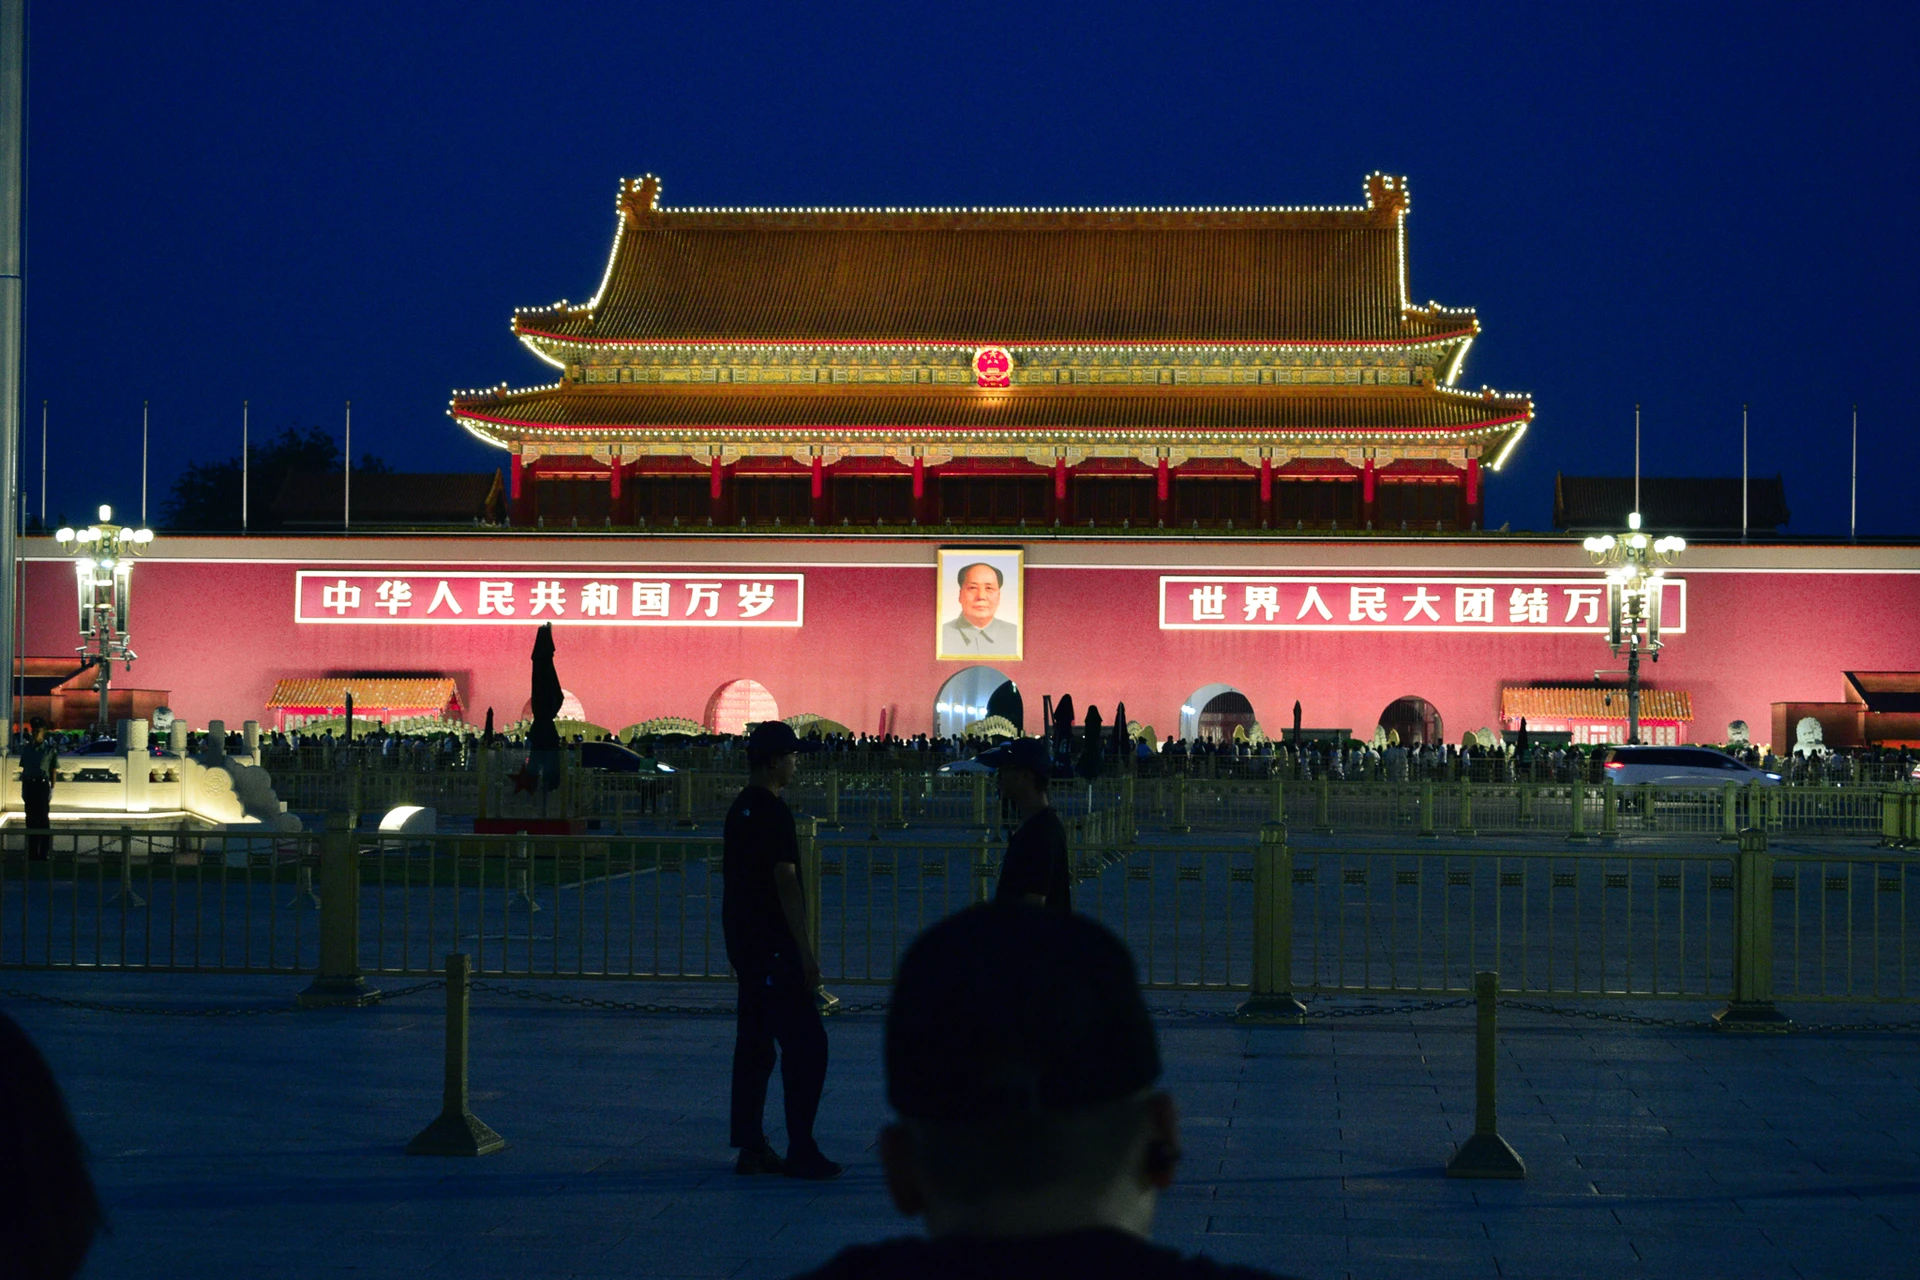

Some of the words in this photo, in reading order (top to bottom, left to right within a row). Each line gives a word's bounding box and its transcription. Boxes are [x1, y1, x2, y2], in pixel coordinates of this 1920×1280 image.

[322, 580, 776, 618] 中华人民共和国万岁
